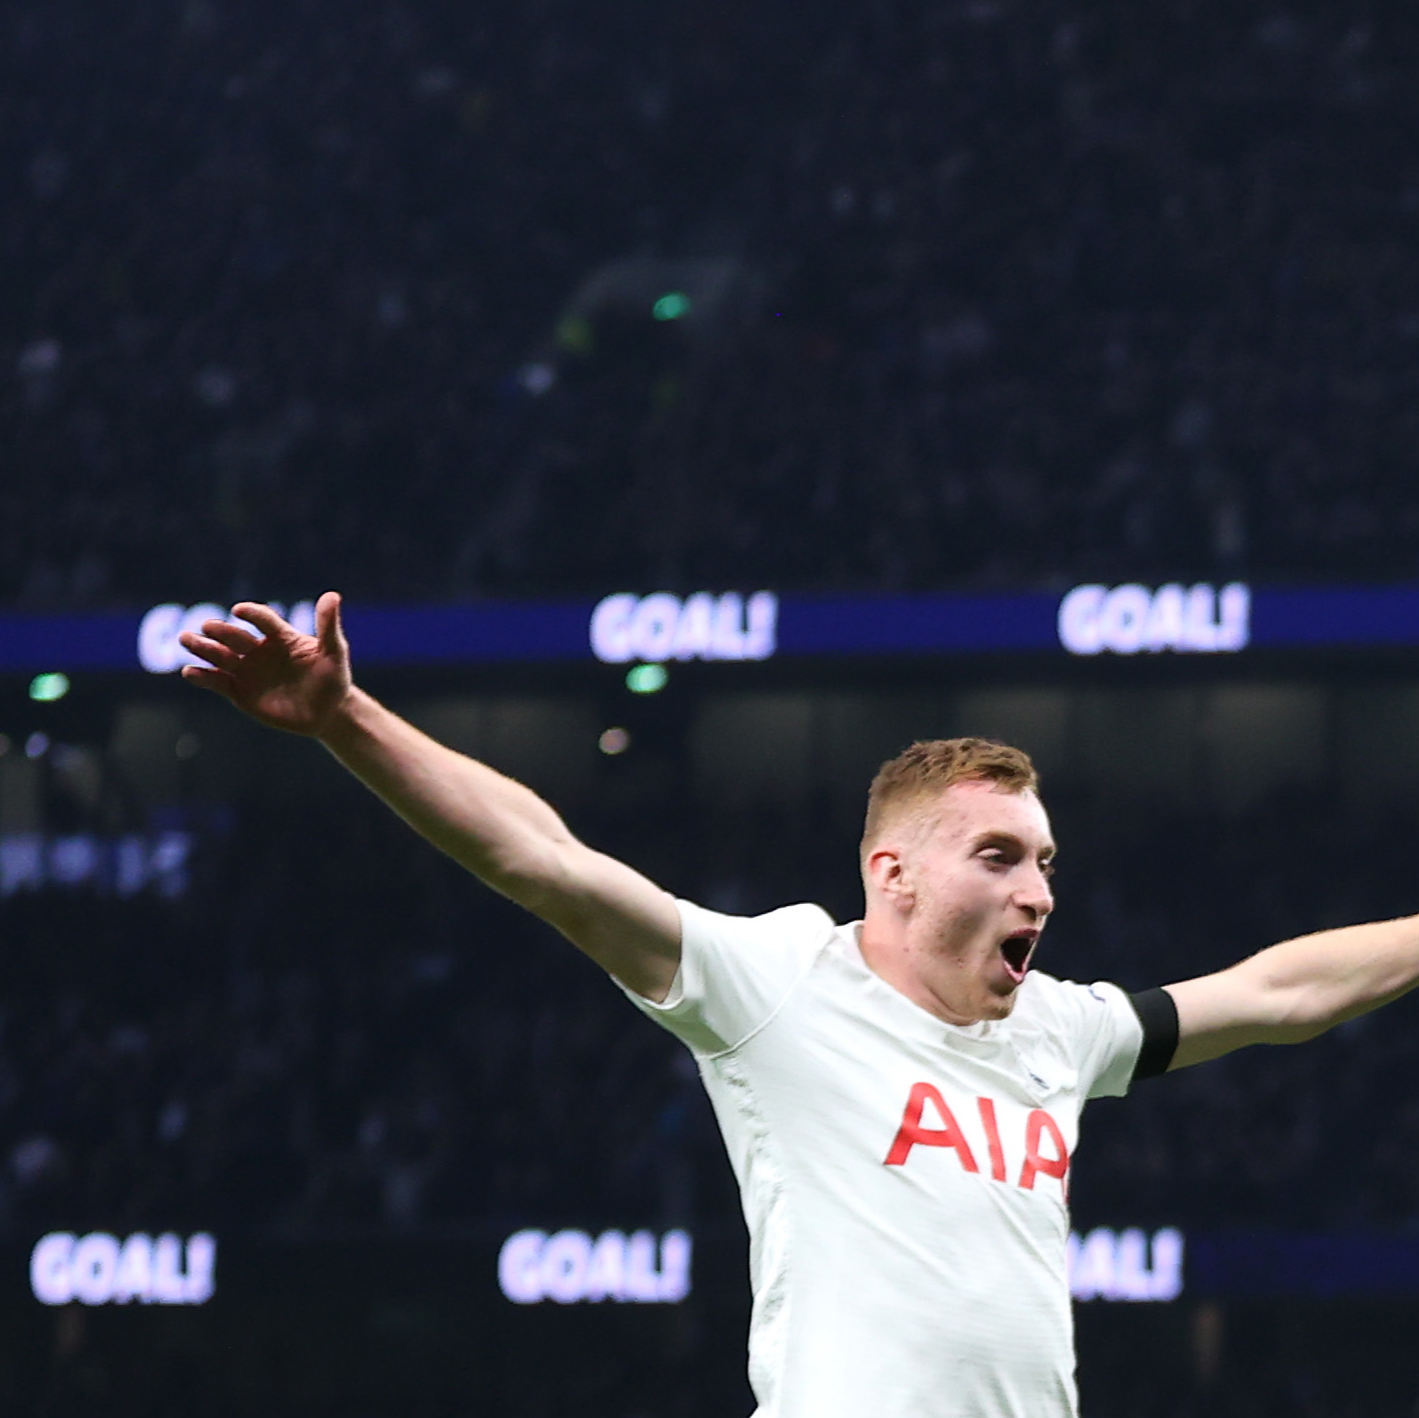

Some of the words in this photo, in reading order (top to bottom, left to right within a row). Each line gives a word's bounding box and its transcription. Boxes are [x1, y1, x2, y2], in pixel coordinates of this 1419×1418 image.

[589, 591, 778, 663] GOAL!
[1058, 583, 1250, 655] GOAL!
[883, 1081, 1069, 1203] AIA
[30, 1232, 215, 1305] GOAL!
[498, 1230, 692, 1304] GOAL!
[1067, 1227, 1184, 1302] AL!
